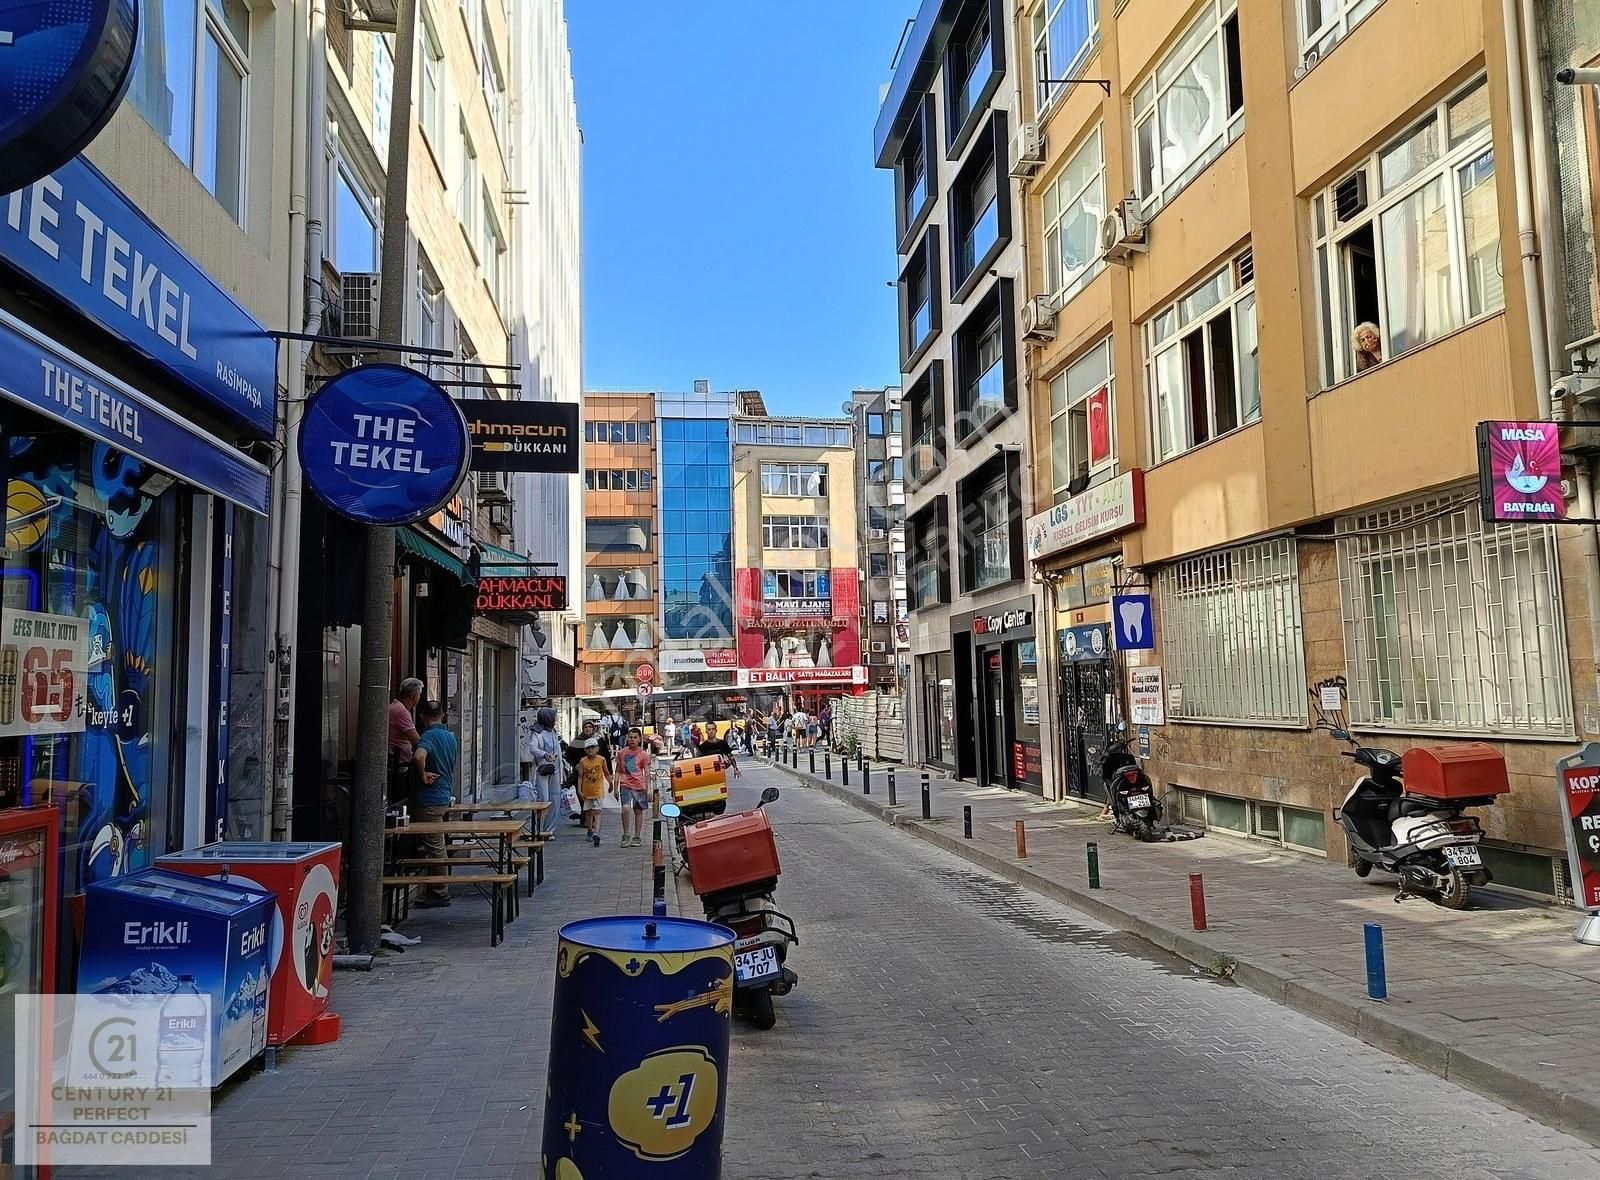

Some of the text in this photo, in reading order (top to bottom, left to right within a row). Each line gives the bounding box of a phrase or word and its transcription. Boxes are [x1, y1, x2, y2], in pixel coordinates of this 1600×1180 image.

[75, 199, 198, 361] TEKEL
[216, 359, 262, 409] RASİMPAŞA
[41, 358, 143, 444] THE TEKEL
[353, 413, 416, 443] THE
[1501, 428, 1546, 441] MASA
[330, 441, 431, 474] TEKEL
[503, 441, 567, 454] DÜKKANI
[1049, 504, 1068, 527] LGS
[1075, 492, 1094, 516] TYT
[1100, 503, 1124, 523] KURSU
[1503, 501, 1556, 514] BAYRAĞI
[477, 579, 563, 593] AHMACUN
[476, 592, 553, 609] DÜKKANI
[775, 600, 831, 609] MAVİ AJANS
[13, 618, 78, 641] EFES MALT KUTU
[987, 615, 1003, 635] Copy
[1003, 609, 1027, 629] Center
[21, 646, 74, 724] 65
[750, 672, 763, 682] ET
[765, 672, 796, 682] BALIK
[91, 707, 119, 729] keyfe
[1569, 775, 1600, 790] KOP
[1446, 847, 1458, 856] 34
[1458, 856, 1475, 864] 804
[123, 921, 189, 944] Erikli
[240, 922, 265, 956] Erikli
[736, 953, 750, 967] 34
[749, 961, 770, 977] 707
[168, 1018, 196, 1030] Erikli
[645, 1072, 696, 1132] +1
